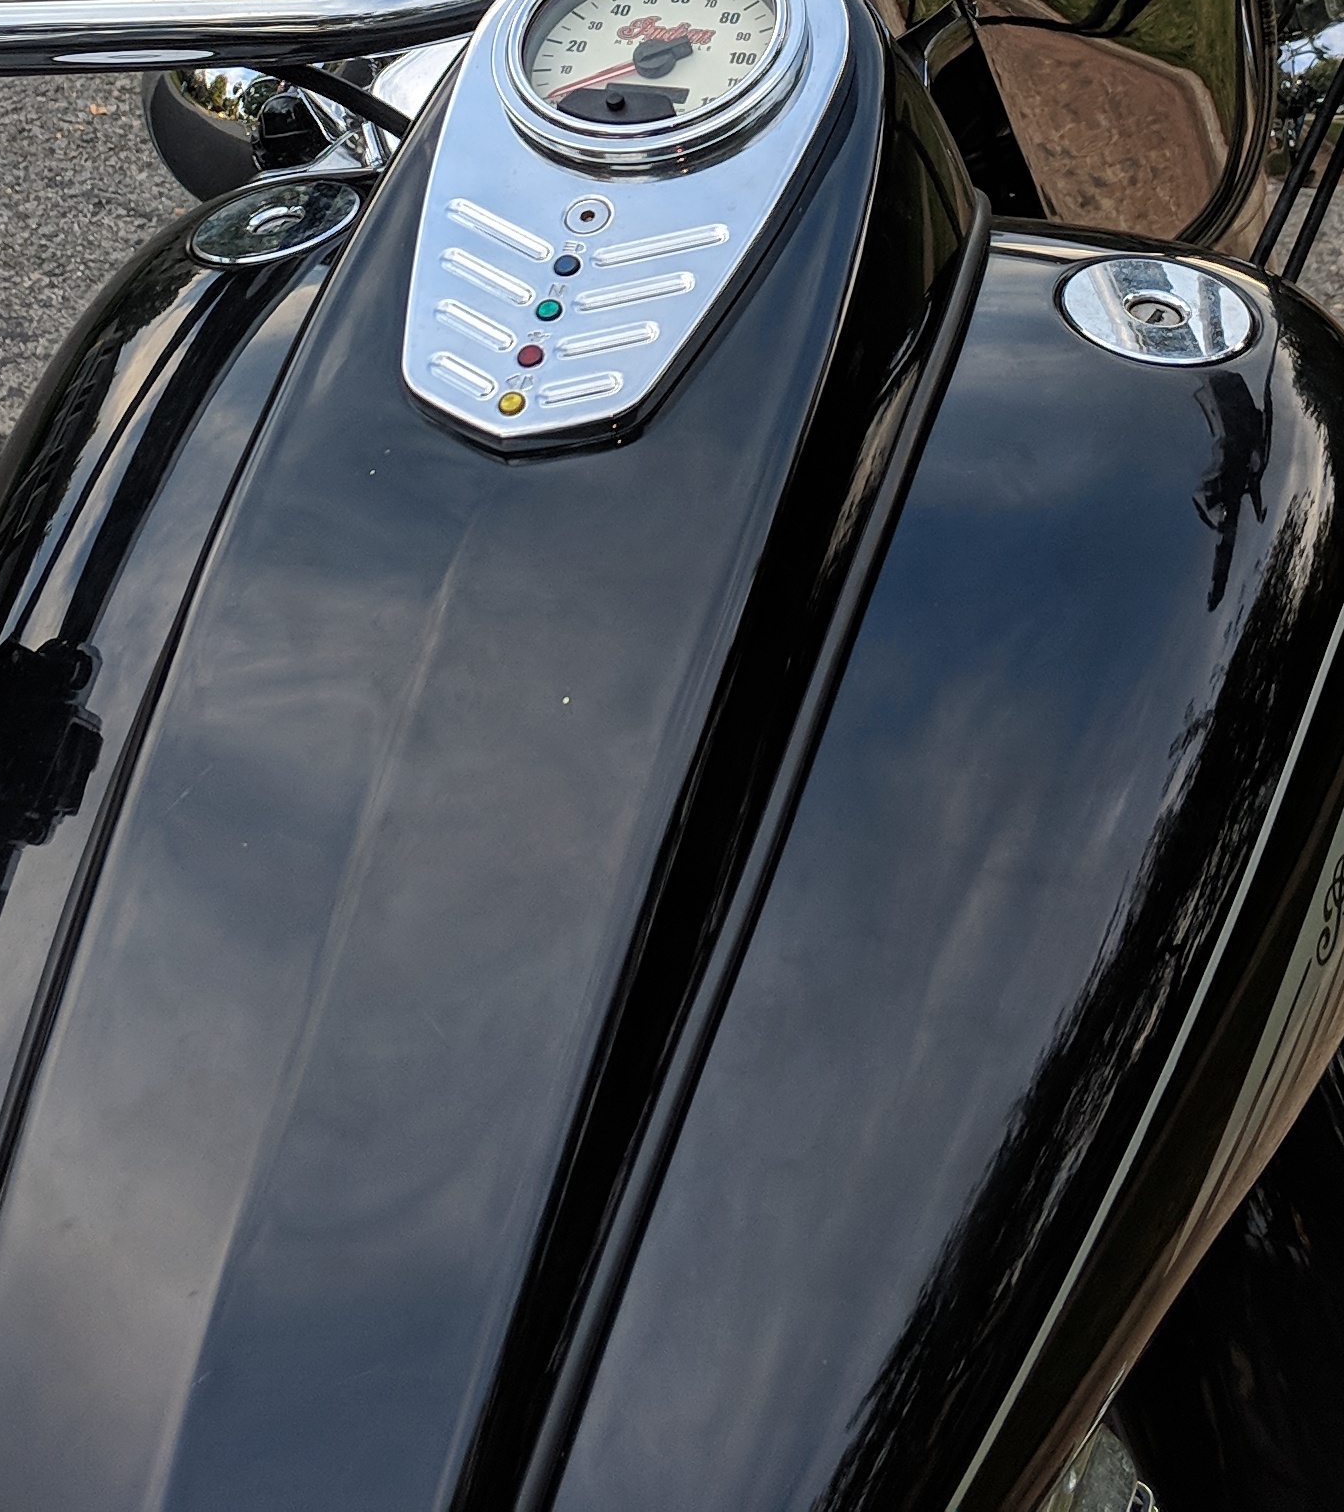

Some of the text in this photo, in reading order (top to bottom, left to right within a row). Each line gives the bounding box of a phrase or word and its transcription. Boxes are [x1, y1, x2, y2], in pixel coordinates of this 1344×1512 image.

[610, 3, 632, 17] 40
[719, 11, 742, 25] 80
[587, 20, 604, 31] 30
[736, 31, 752, 42] 90
[566, 39, 588, 53] 20
[729, 51, 758, 65] 100
[560, 64, 573, 75] 10
